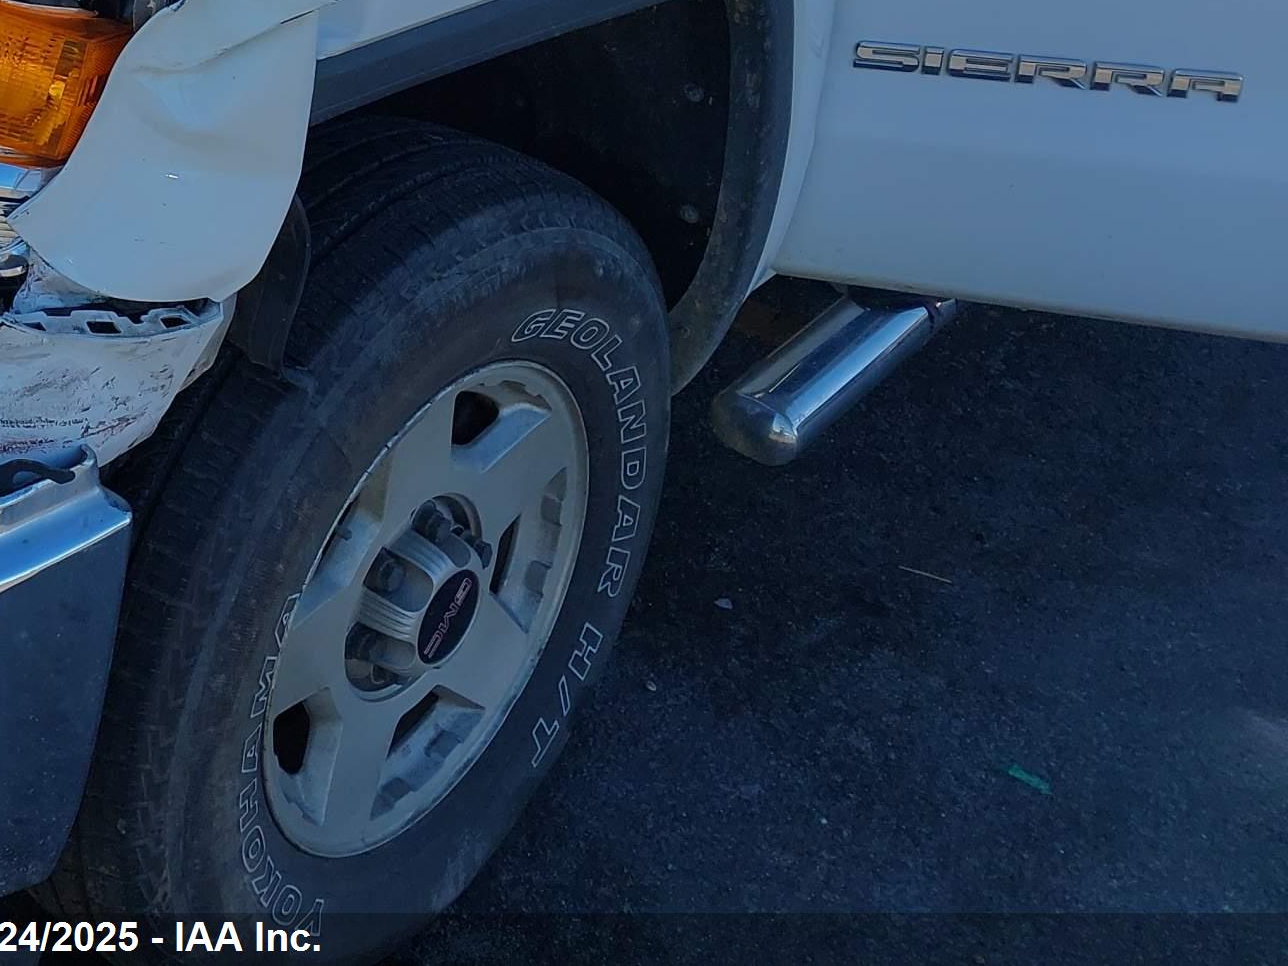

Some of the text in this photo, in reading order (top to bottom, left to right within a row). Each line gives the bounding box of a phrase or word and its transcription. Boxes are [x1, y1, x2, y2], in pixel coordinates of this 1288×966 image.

[852, 40, 1244, 103] SIERRA
[511, 307, 647, 768] GEOLANDAR H/T
[423, 577, 471, 658] GMC
